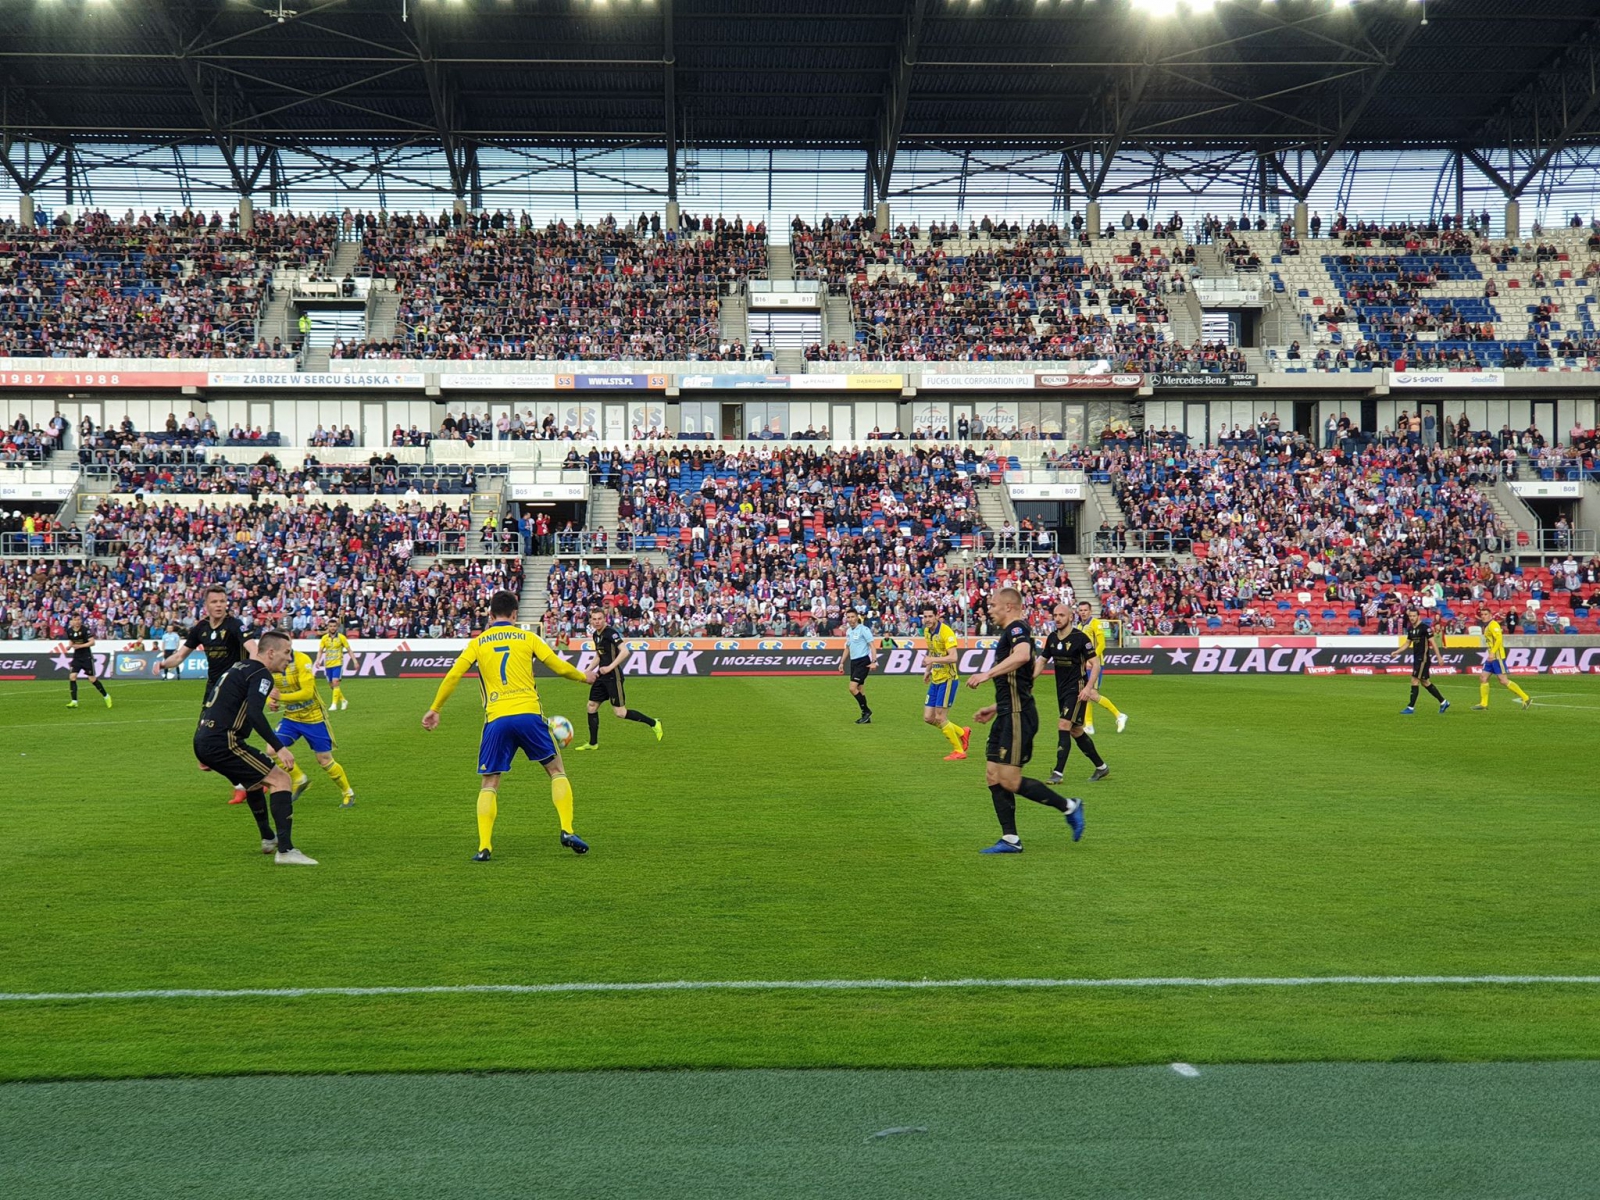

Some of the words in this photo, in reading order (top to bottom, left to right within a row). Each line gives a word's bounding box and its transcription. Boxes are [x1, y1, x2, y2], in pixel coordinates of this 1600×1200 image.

[0, 374, 46, 384] 1987
[74, 374, 120, 384] 1988
[243, 375, 287, 384] ZABRZE
[290, 375, 301, 384] W
[304, 375, 341, 384] SERCU
[344, 374, 390, 386] ŚLĄSKA
[1016, 377, 1029, 386] (PL)
[1162, 376, 1226, 385] Mercedes-Benz
[565, 407, 596, 428] STS
[632, 407, 662, 428] STS
[981, 415, 1015, 423] FUCHS
[479, 632, 526, 646] JANKOWSKI
[576, 651, 703, 675] BACK
[713, 657, 719, 665] I
[722, 654, 782, 665] MOŻESZ
[1192, 649, 1322, 672] BLACK
[1331, 655, 1337, 663] I
[1340, 653, 1401, 663] MOŻESZ
[493, 646, 510, 685] 7
[1308, 666, 1335, 674] Henryk
